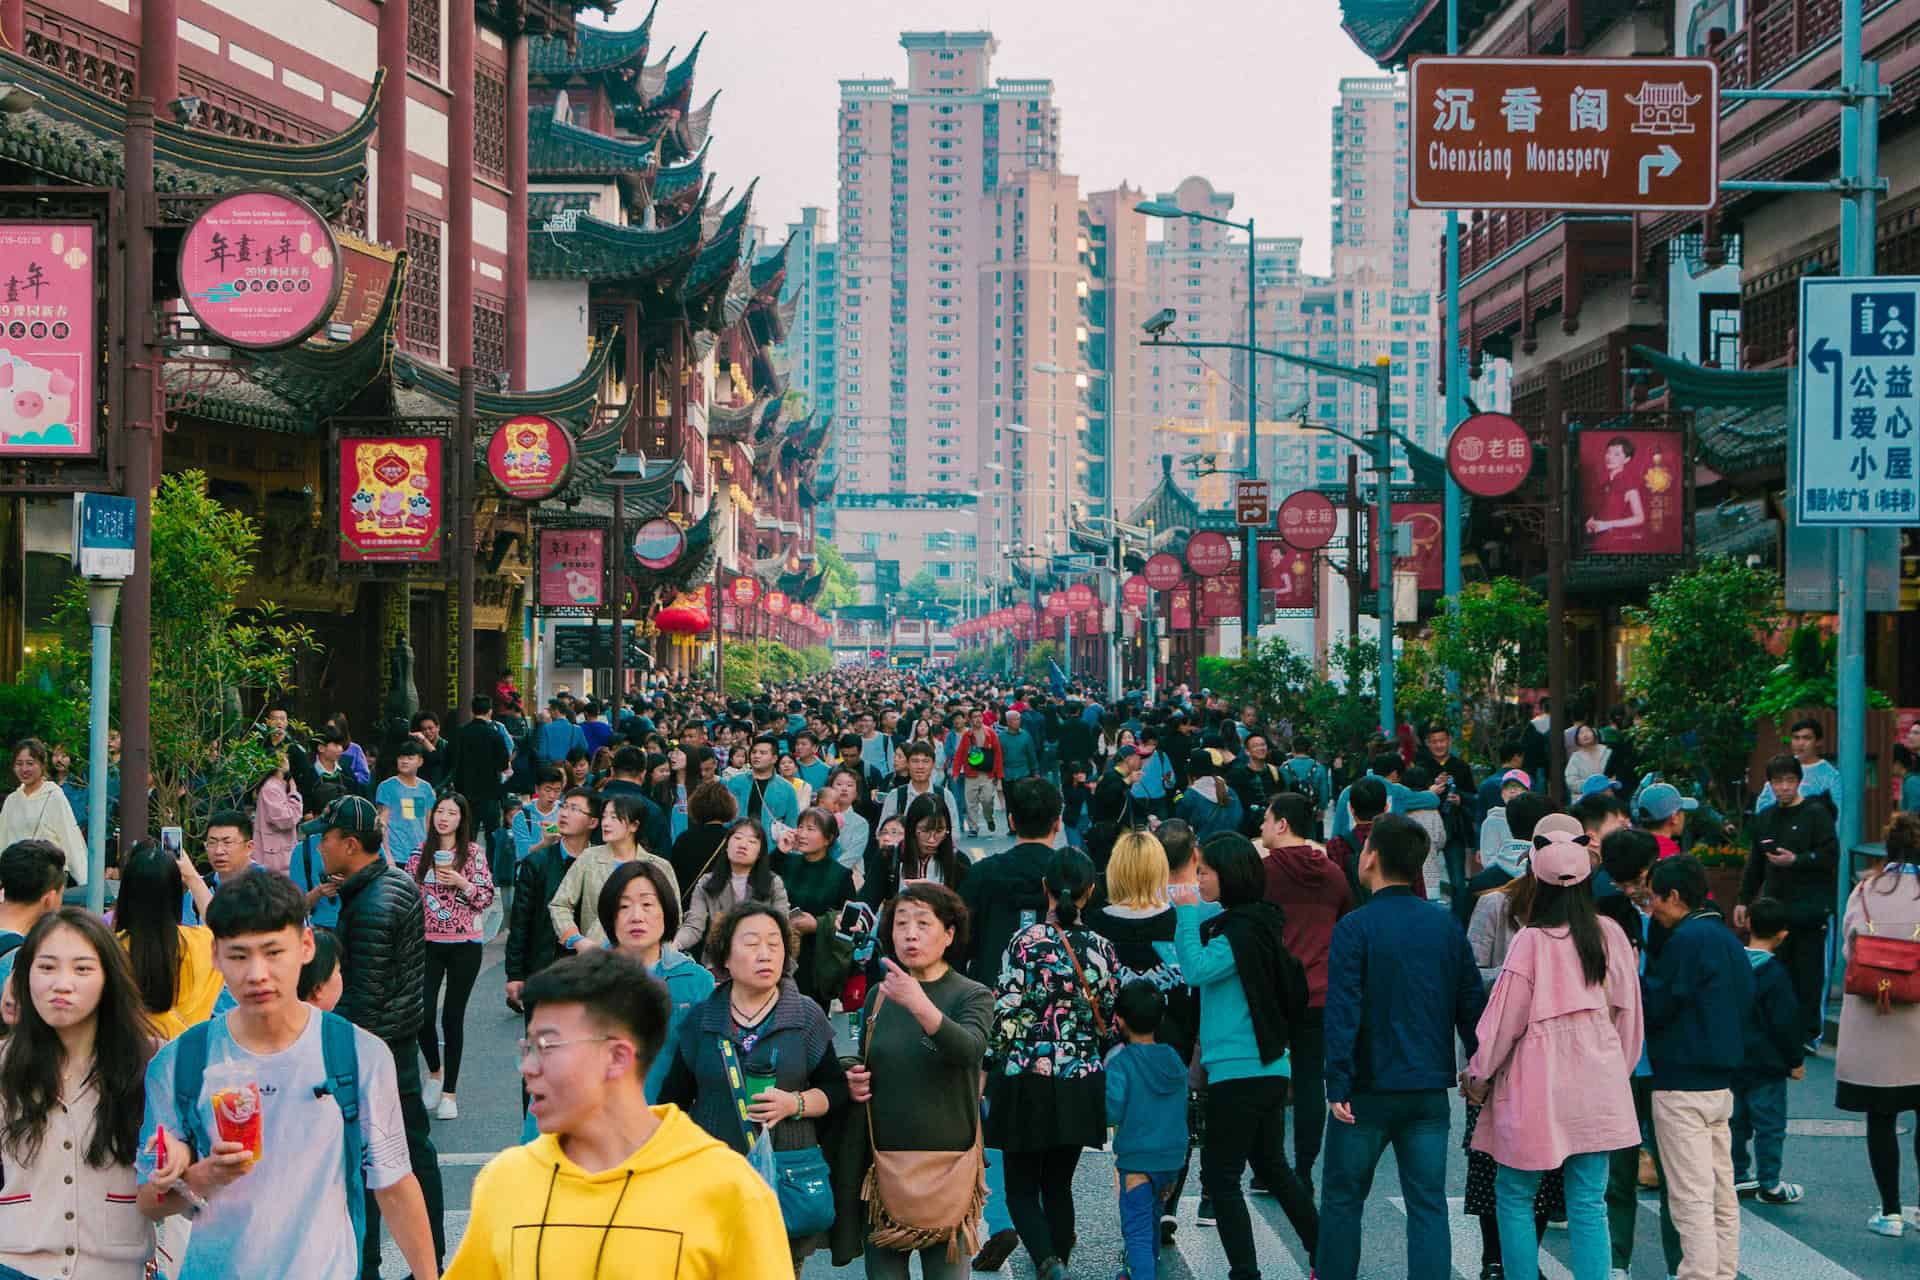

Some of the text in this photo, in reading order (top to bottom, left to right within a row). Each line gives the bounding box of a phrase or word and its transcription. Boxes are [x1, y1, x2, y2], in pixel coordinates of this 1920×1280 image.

[1432, 86, 1608, 132] 沉香阁
[1429, 140, 1610, 179] Chenxiang Monaspery
[1850, 364, 1913, 399] 公益
[1850, 406, 1913, 440] 爱心
[1487, 437, 1525, 458] 老庙
[1849, 446, 1913, 480] 小屋
